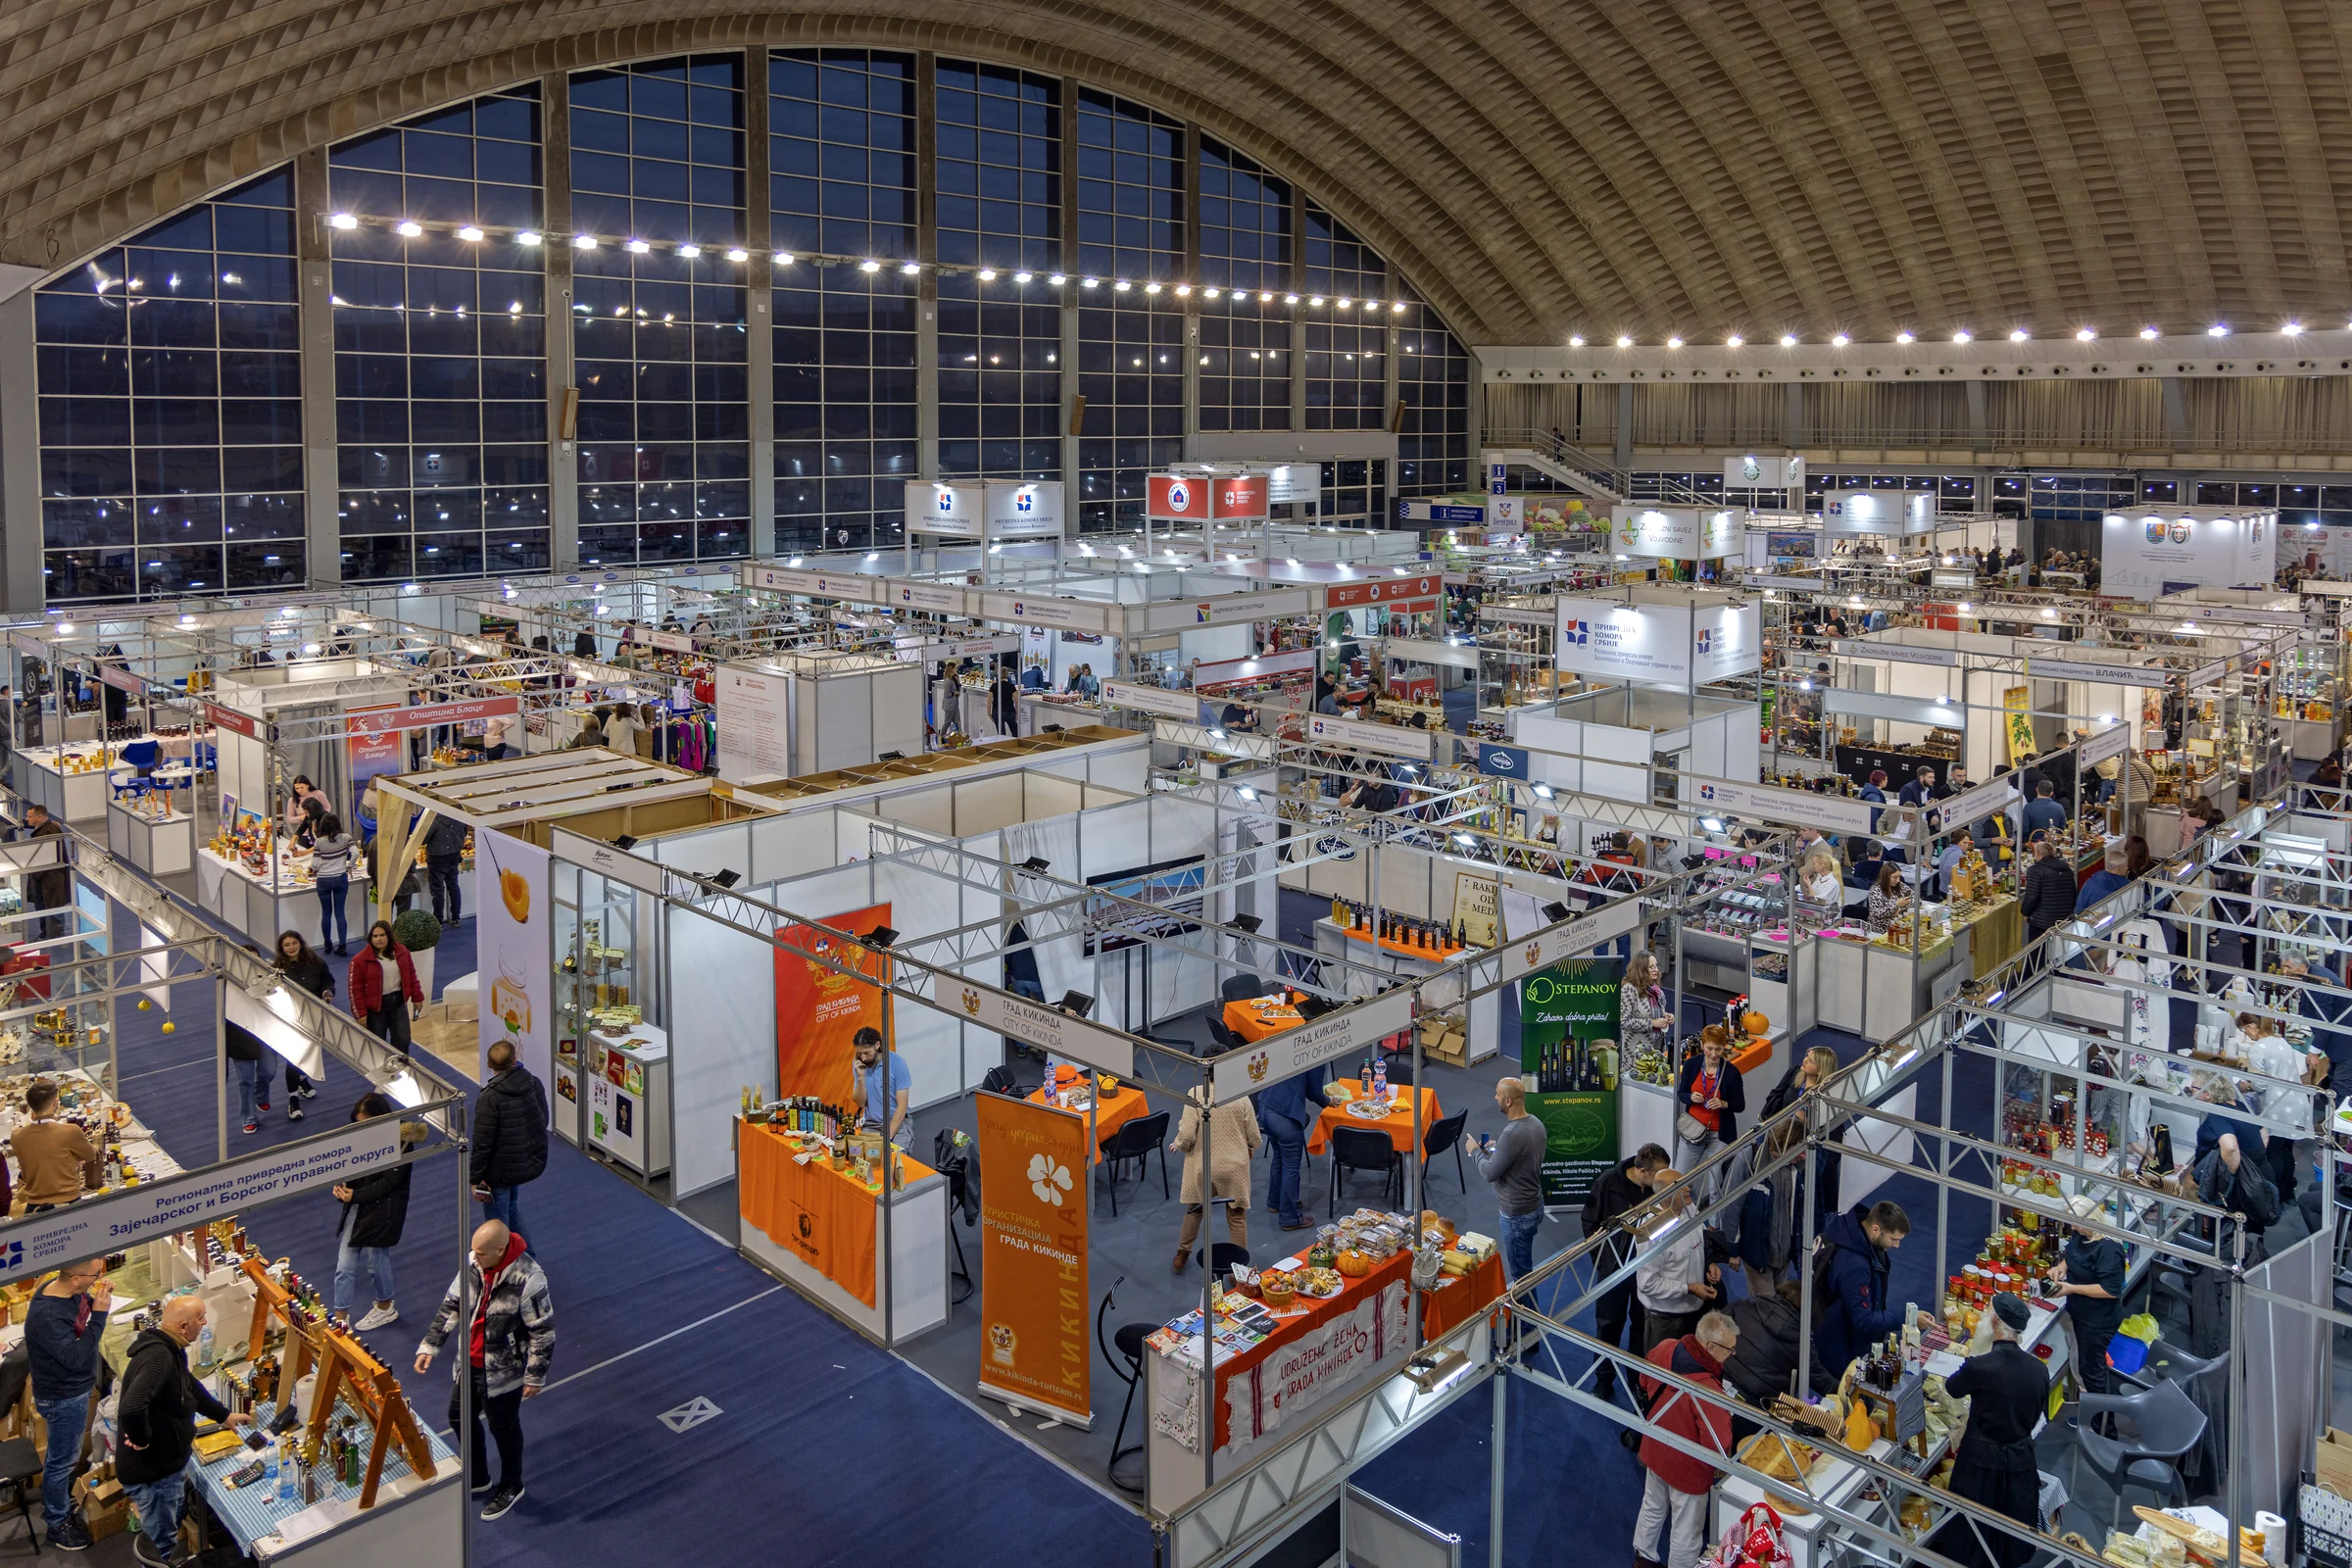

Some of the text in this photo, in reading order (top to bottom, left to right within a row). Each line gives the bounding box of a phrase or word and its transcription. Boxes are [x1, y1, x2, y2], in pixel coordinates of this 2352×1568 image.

[1594, 631, 1623, 641] КОМОРА
[1911, 652, 1943, 661] VOJVODINE
[2060, 667, 2093, 676] ГАЗДИНСТВО
[2095, 668, 2133, 680] ВЛАЧИЋ
[410, 705, 484, 719] Општина Блаце
[359, 745, 392, 754] Општина
[1750, 795, 1778, 806] Регионална
[1779, 800, 1804, 808] привредна
[1750, 801, 1783, 811] Браничевског
[1789, 807, 1820, 817] Подунавског
[1821, 812, 1844, 821] управног
[1472, 881, 1497, 897] RAKIJ
[1480, 894, 1494, 905] OD
[1557, 918, 1597, 941] ГРАД КИКИНДА
[1557, 932, 1598, 956] CITY OF KIKINDA
[1555, 983, 1617, 995] STEPANOV
[815, 1013, 829, 1023] CITY
[841, 1004, 861, 1015] KIKINDA
[816, 994, 860, 1012] ГРАД КИКИНДА
[1004, 1000, 1060, 1029] ГРАД КИКИНДА
[1536, 1011, 1564, 1022] Zdravo
[1565, 1011, 1586, 1021] dobra
[1004, 1016, 1062, 1049] CITY OF KIKINDA
[1294, 1018, 1350, 1049] ГРАД КИКИНДА
[1294, 1035, 1352, 1066] CITY OF KIKINDA
[156, 1145, 352, 1209] Регионална привредна комора
[110, 1144, 395, 1238] Зајечарског и Борског управног округа
[984, 1204, 1041, 1229] ТУРИСТИЧКА
[33, 1222, 88, 1243] ПРИВРЕДНА
[983, 1216, 1052, 1245] ОРГАНИЗАЦИЈА
[33, 1236, 72, 1251] КОМОРА
[33, 1245, 67, 1259] СРБИЈЕ
[1000, 1235, 1078, 1264] ГРАДА КИКИНДЕ
[1057, 1207, 1084, 1390] КИКИНДА
[1334, 1323, 1359, 1348] ŽENA
[984, 1363, 1083, 1401] www.kikinda-turizam.rs
[1287, 1371, 1314, 1398] GRADA
